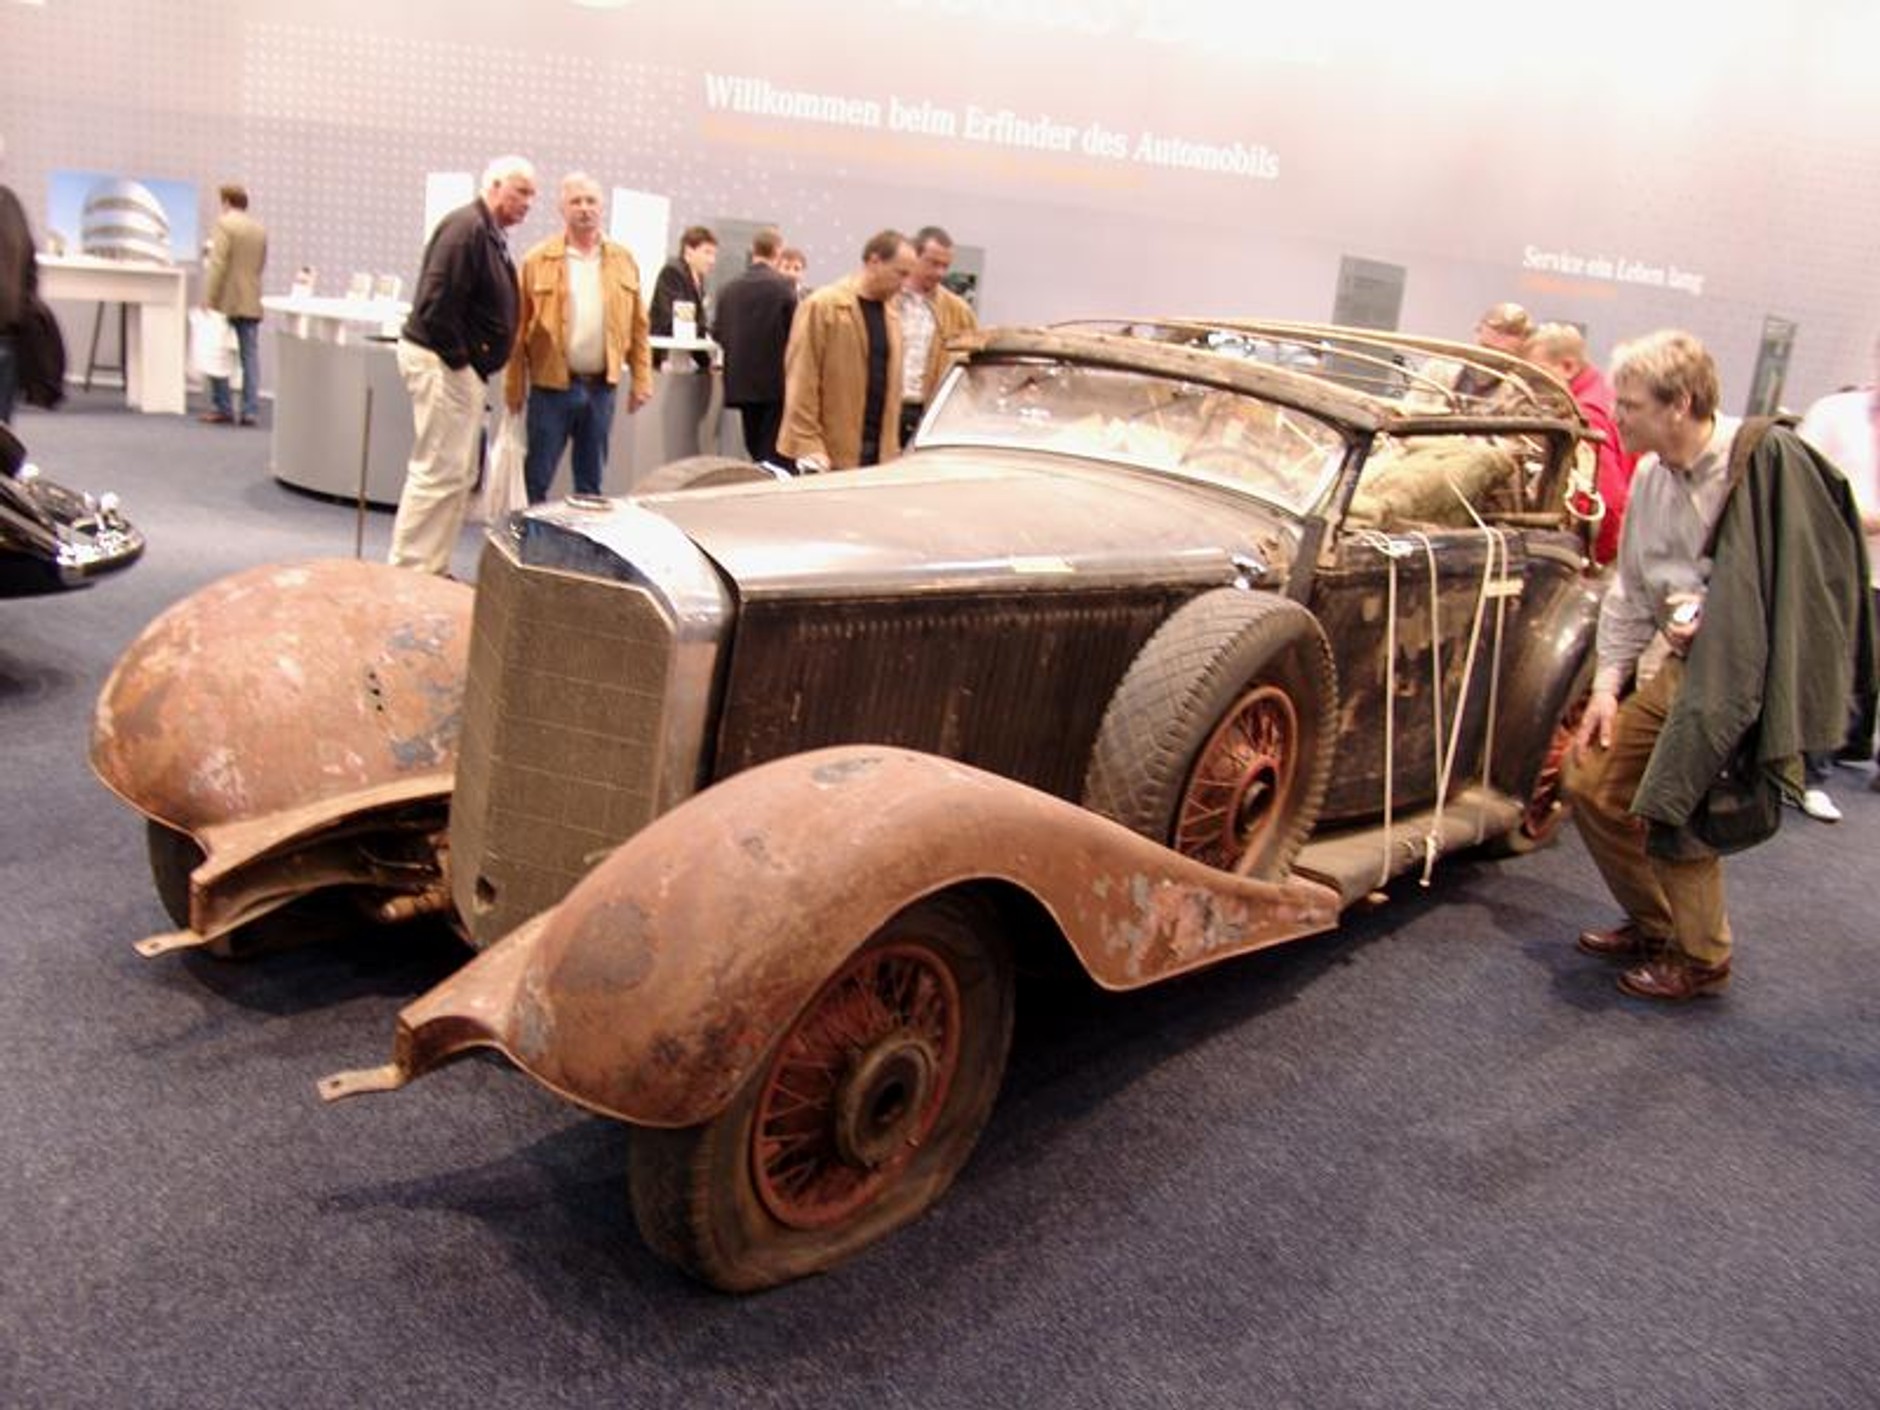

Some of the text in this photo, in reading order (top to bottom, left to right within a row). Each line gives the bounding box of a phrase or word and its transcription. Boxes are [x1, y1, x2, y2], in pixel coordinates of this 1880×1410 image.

[704, 72, 1280, 180] Willkommen beim Erfinder des Automobils
[1522, 245, 1583, 276] Service
[1616, 256, 1665, 286] Leben
